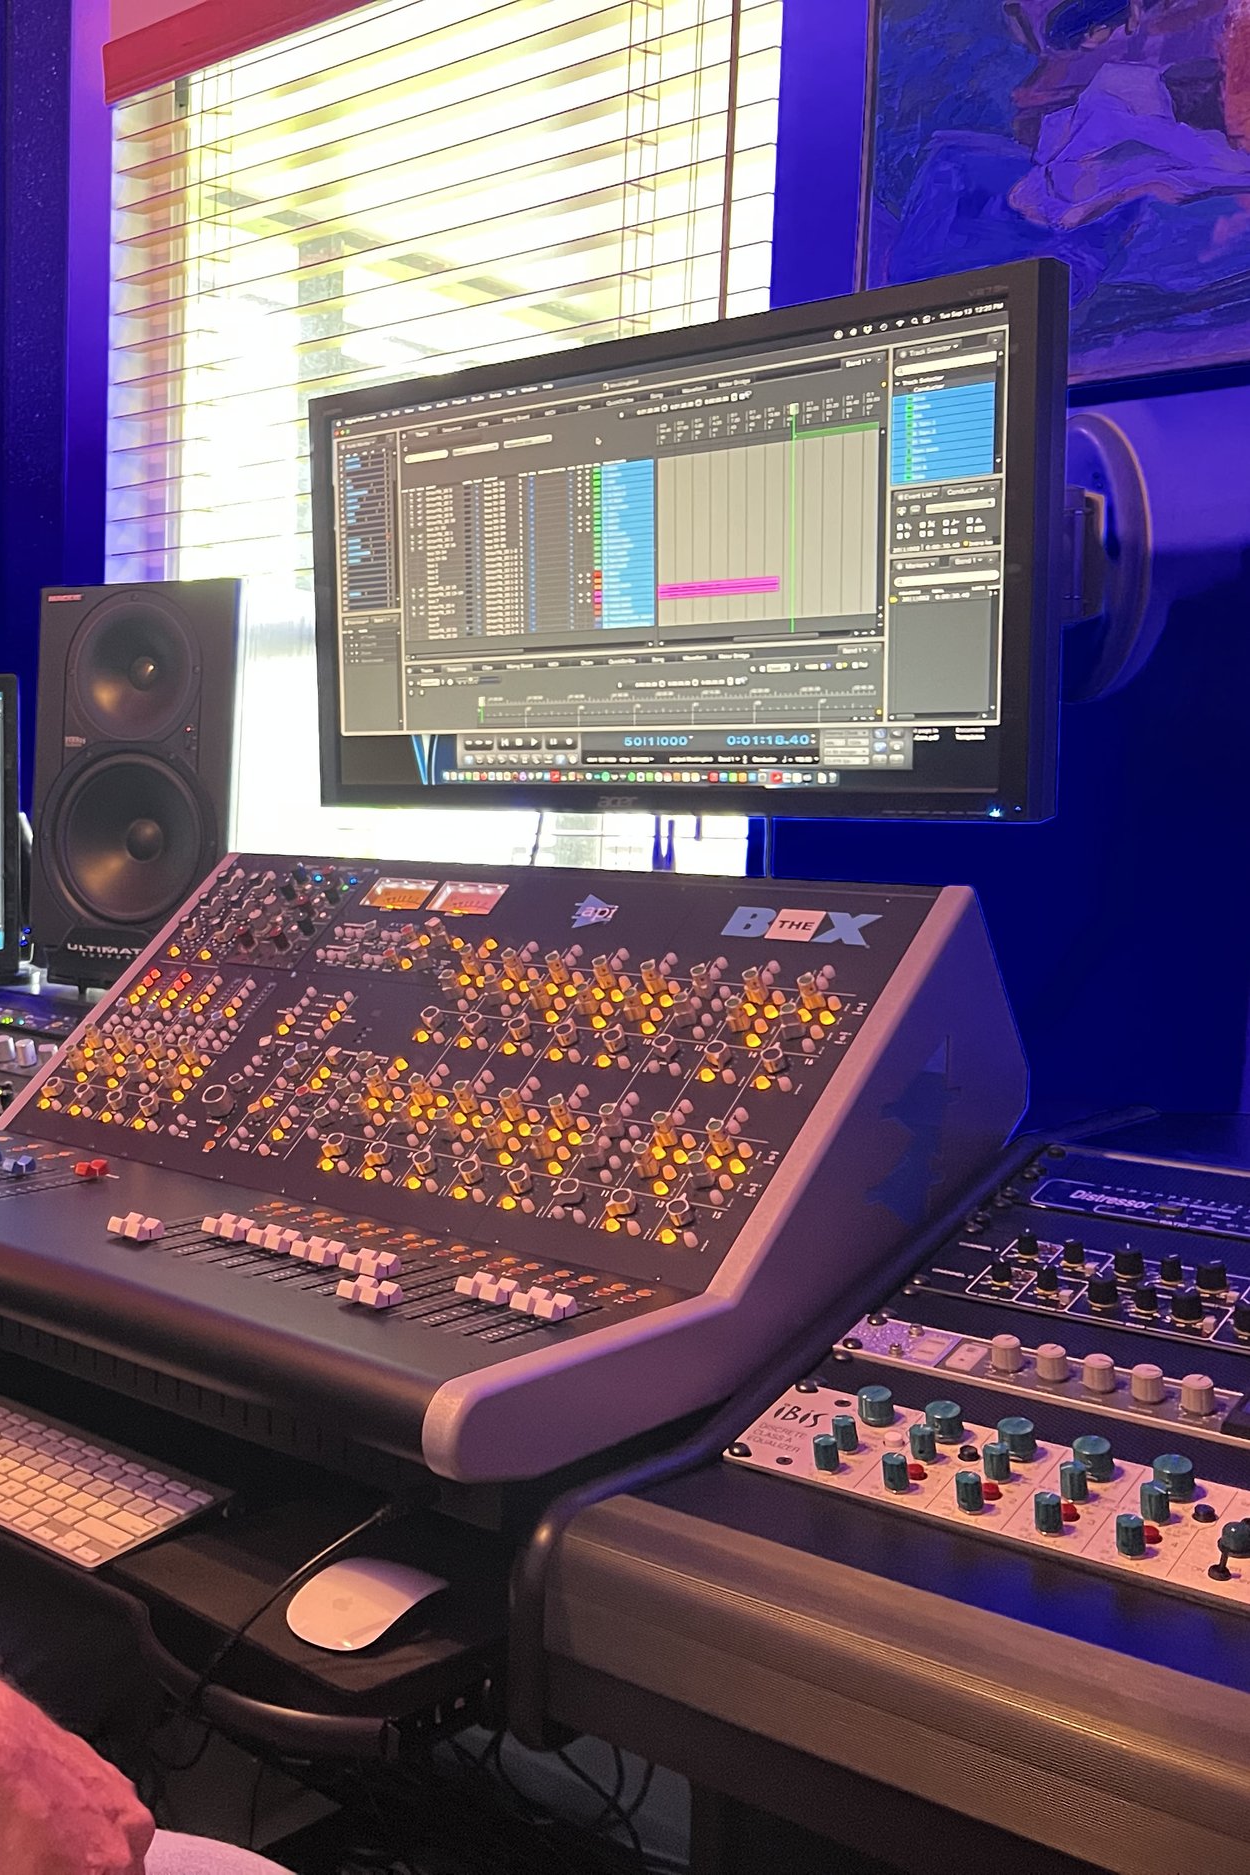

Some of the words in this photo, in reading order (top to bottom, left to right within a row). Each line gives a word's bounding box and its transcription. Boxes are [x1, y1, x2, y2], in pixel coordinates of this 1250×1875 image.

[598, 796, 638, 808] acer
[581, 904, 618, 923] api
[778, 919, 816, 932] THE
[67, 943, 144, 955] ULTIMAT
[642, 1038, 652, 1046] 10
[694, 1044, 704, 1052] 12
[655, 1200, 665, 1208] 13
[1069, 1189, 1154, 1209] Distressor
[713, 1211, 723, 1219] 15
[753, 1429, 781, 1441] CLASS
[759, 1422, 807, 1438] DISCRETE
[747, 1436, 800, 1453] EQUALIZER
